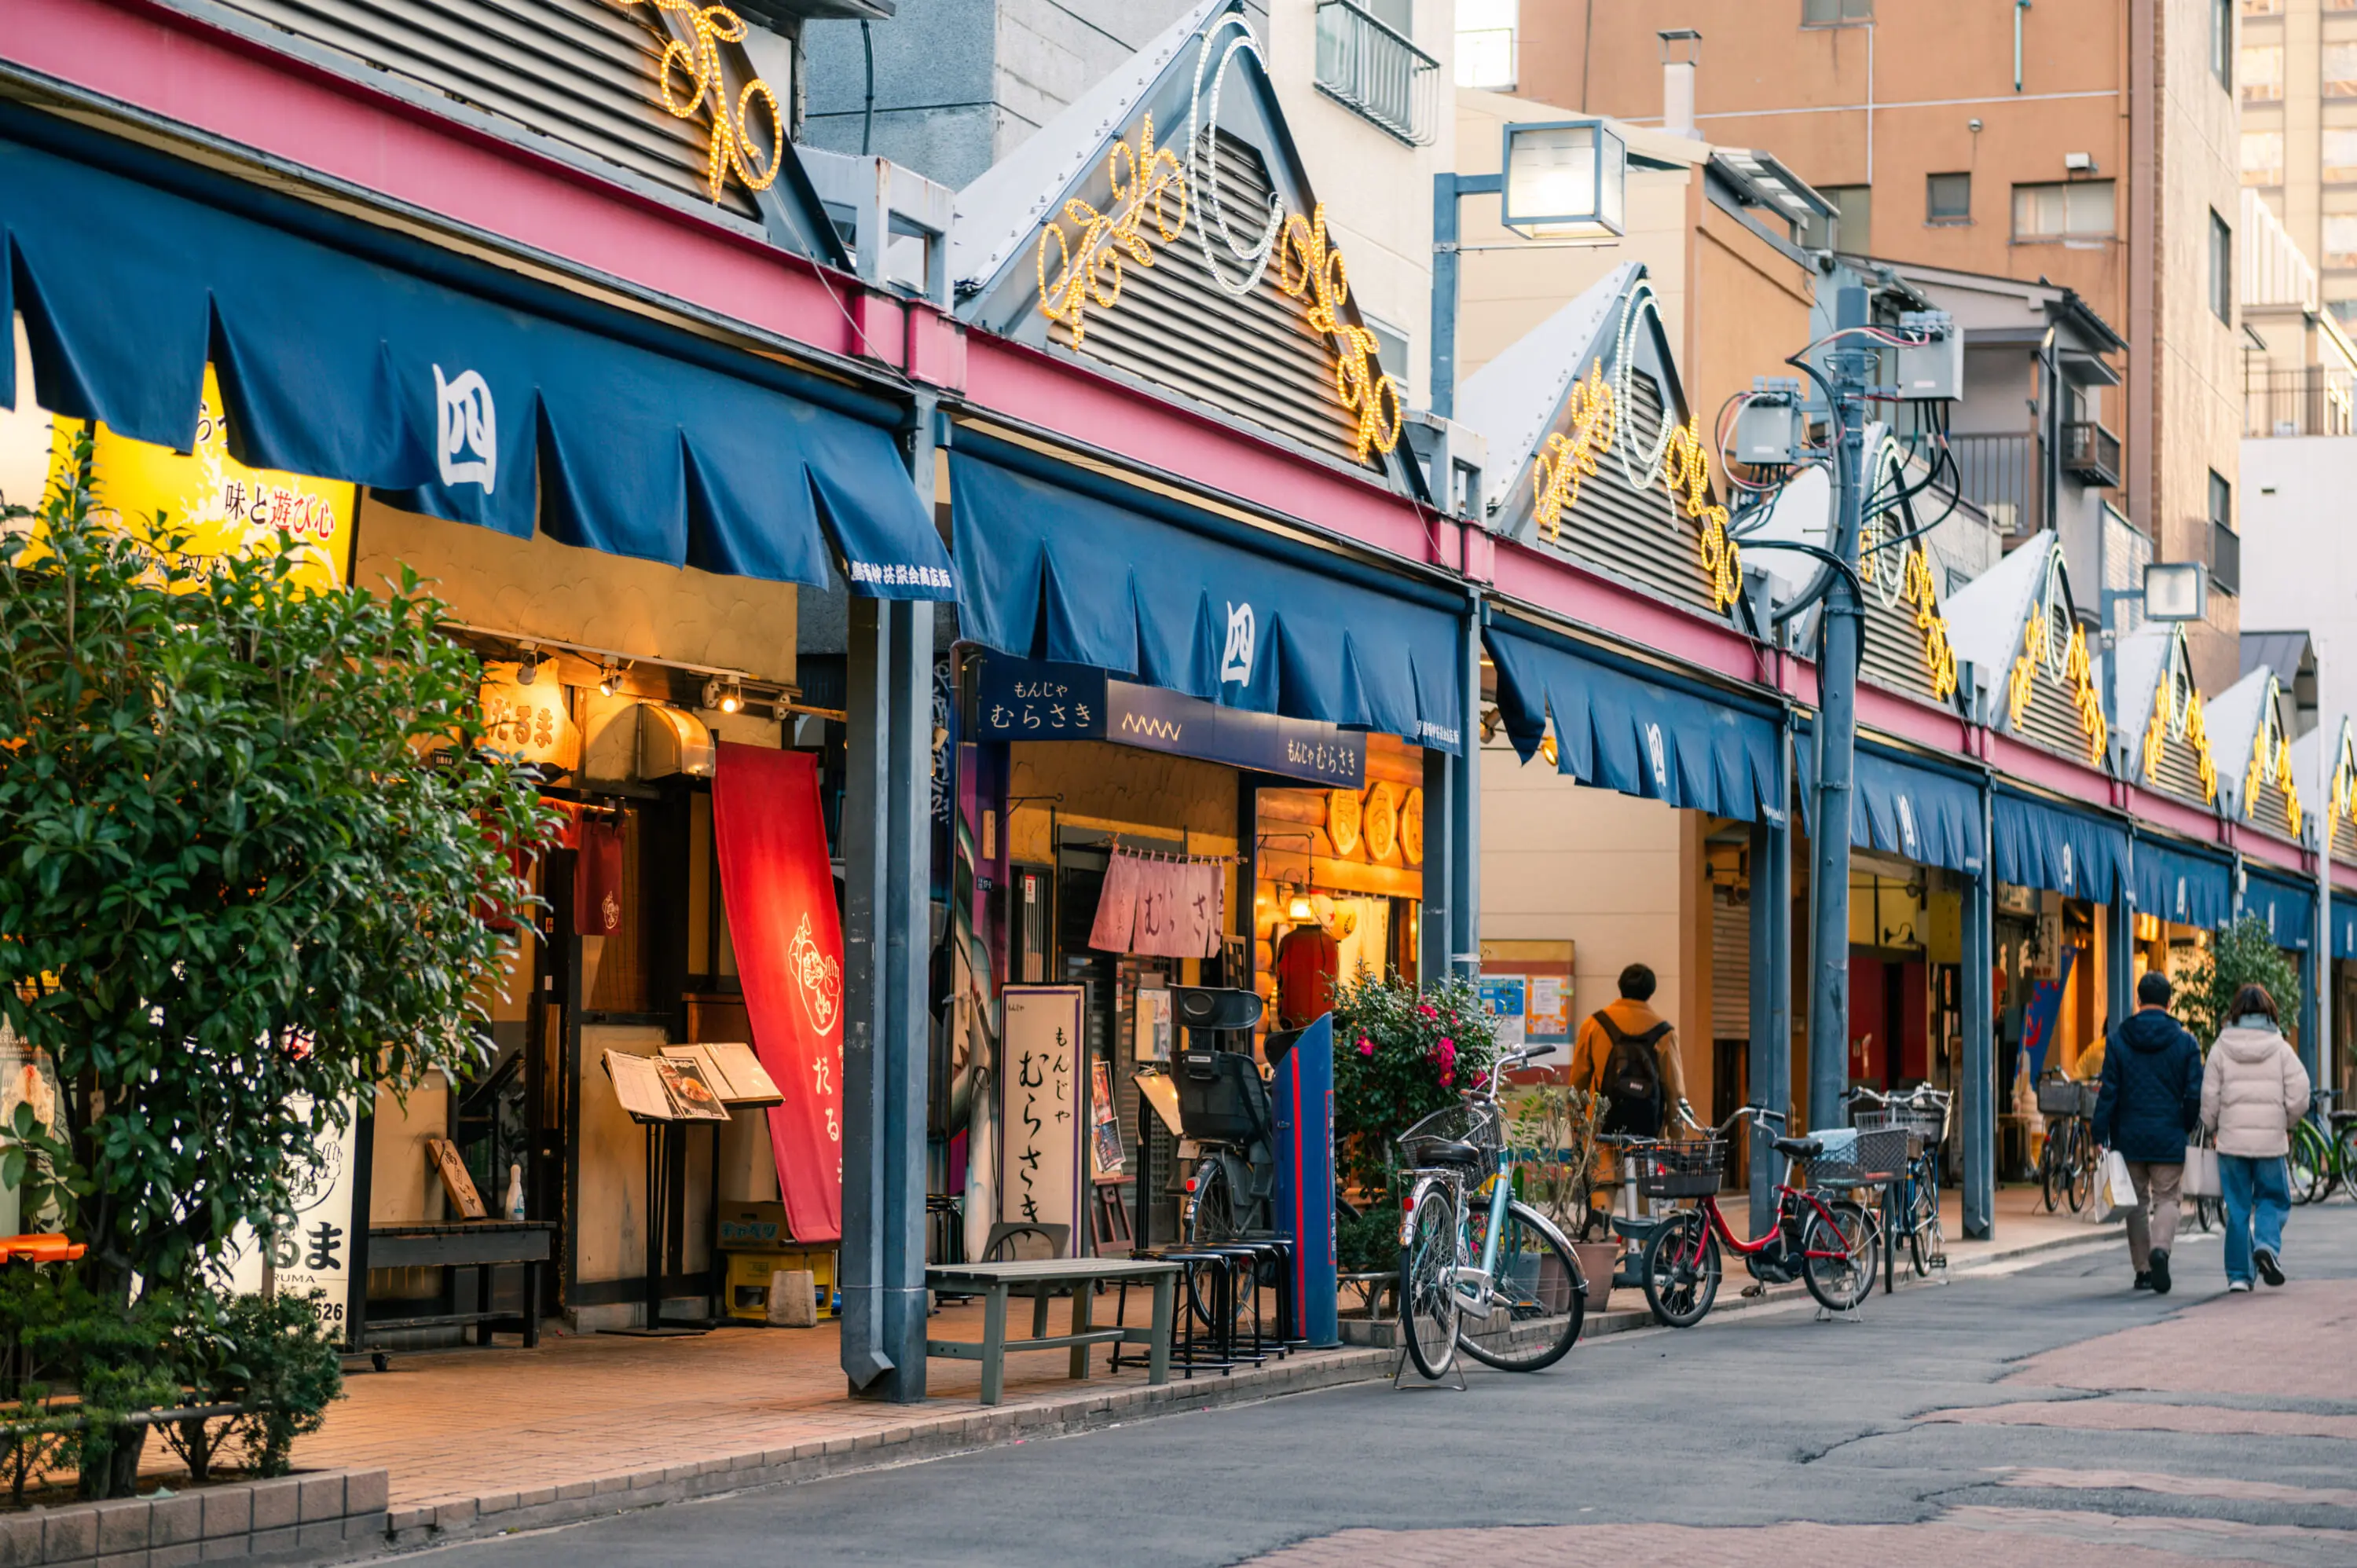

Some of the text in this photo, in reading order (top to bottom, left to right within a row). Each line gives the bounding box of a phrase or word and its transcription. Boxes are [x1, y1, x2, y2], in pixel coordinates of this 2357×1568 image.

[225, 482, 335, 540] 味と遊び心
[1014, 681, 1068, 698] もんじゃ
[491, 698, 553, 749] だるま
[991, 702, 1091, 729] むらさき
[1053, 1027, 1070, 1124] もんじゃ
[1019, 1050, 1049, 1244] むらさき
[275, 1222, 343, 1270] るま
[721, 1220, 779, 1240] キャベツ
[274, 1273, 316, 1284] RUMA
[314, 1302, 343, 1321] 626
